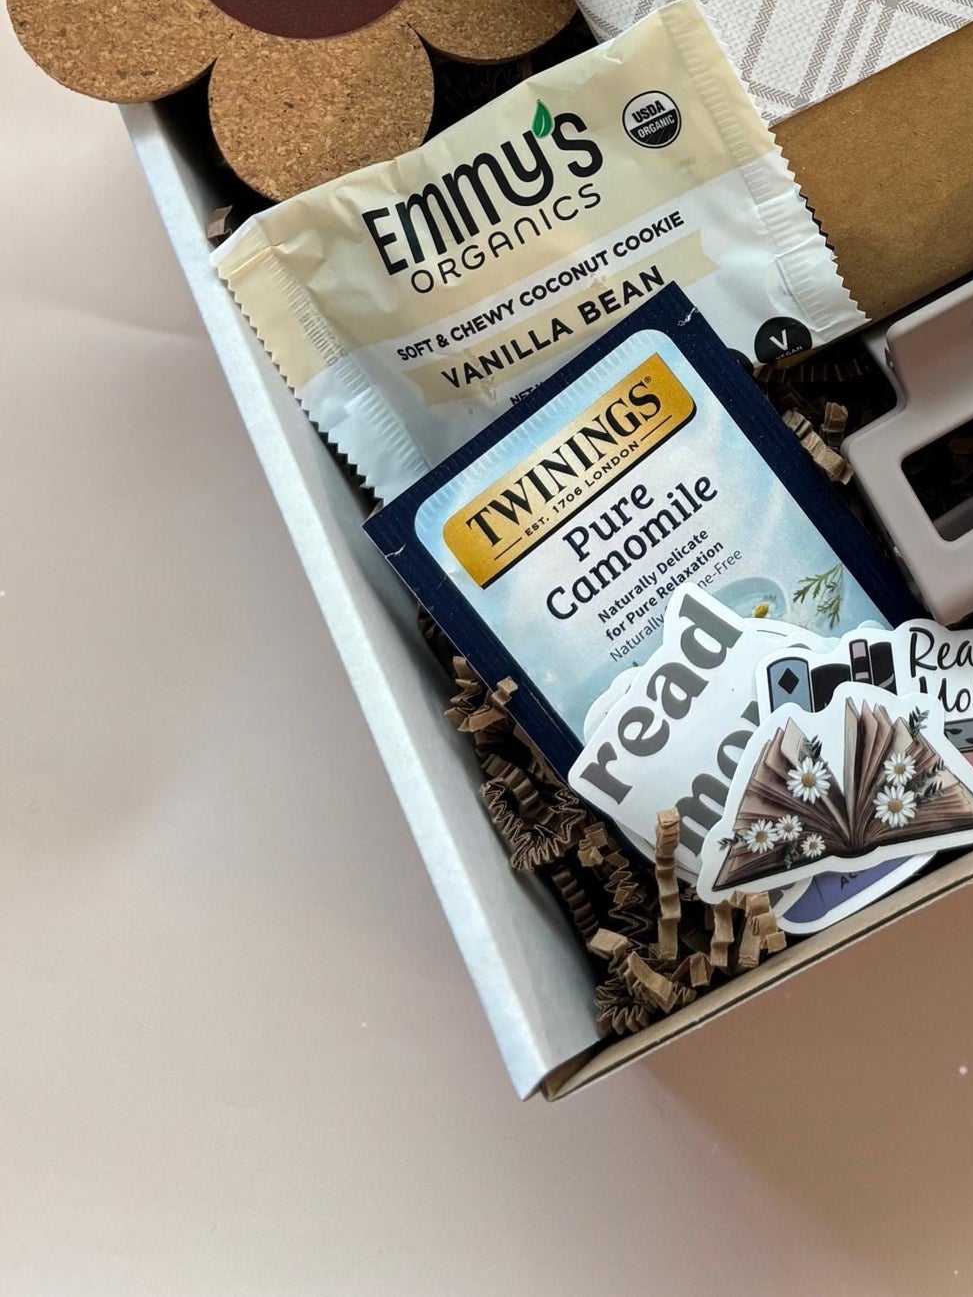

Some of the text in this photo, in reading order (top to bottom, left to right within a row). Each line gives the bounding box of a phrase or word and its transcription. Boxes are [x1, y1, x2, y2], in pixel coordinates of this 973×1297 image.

[631, 100, 666, 123] USDA
[637, 114, 675, 138] ORGANIC
[397, 211, 684, 361] SOFT & CHEWY COCONUT COOKIE
[441, 265, 665, 388] VANILLA BEAN
[465, 381, 662, 547] TWININGS
[524, 440, 639, 537] EST. 1706 LONDON
[546, 476, 718, 620] Camomile
[562, 483, 655, 563] Pure
[597, 529, 709, 623] Naturally Delicate
[605, 541, 724, 641] for Pure Relaxation
[610, 614, 665, 662] Naturally
[580, 593, 744, 805] read
